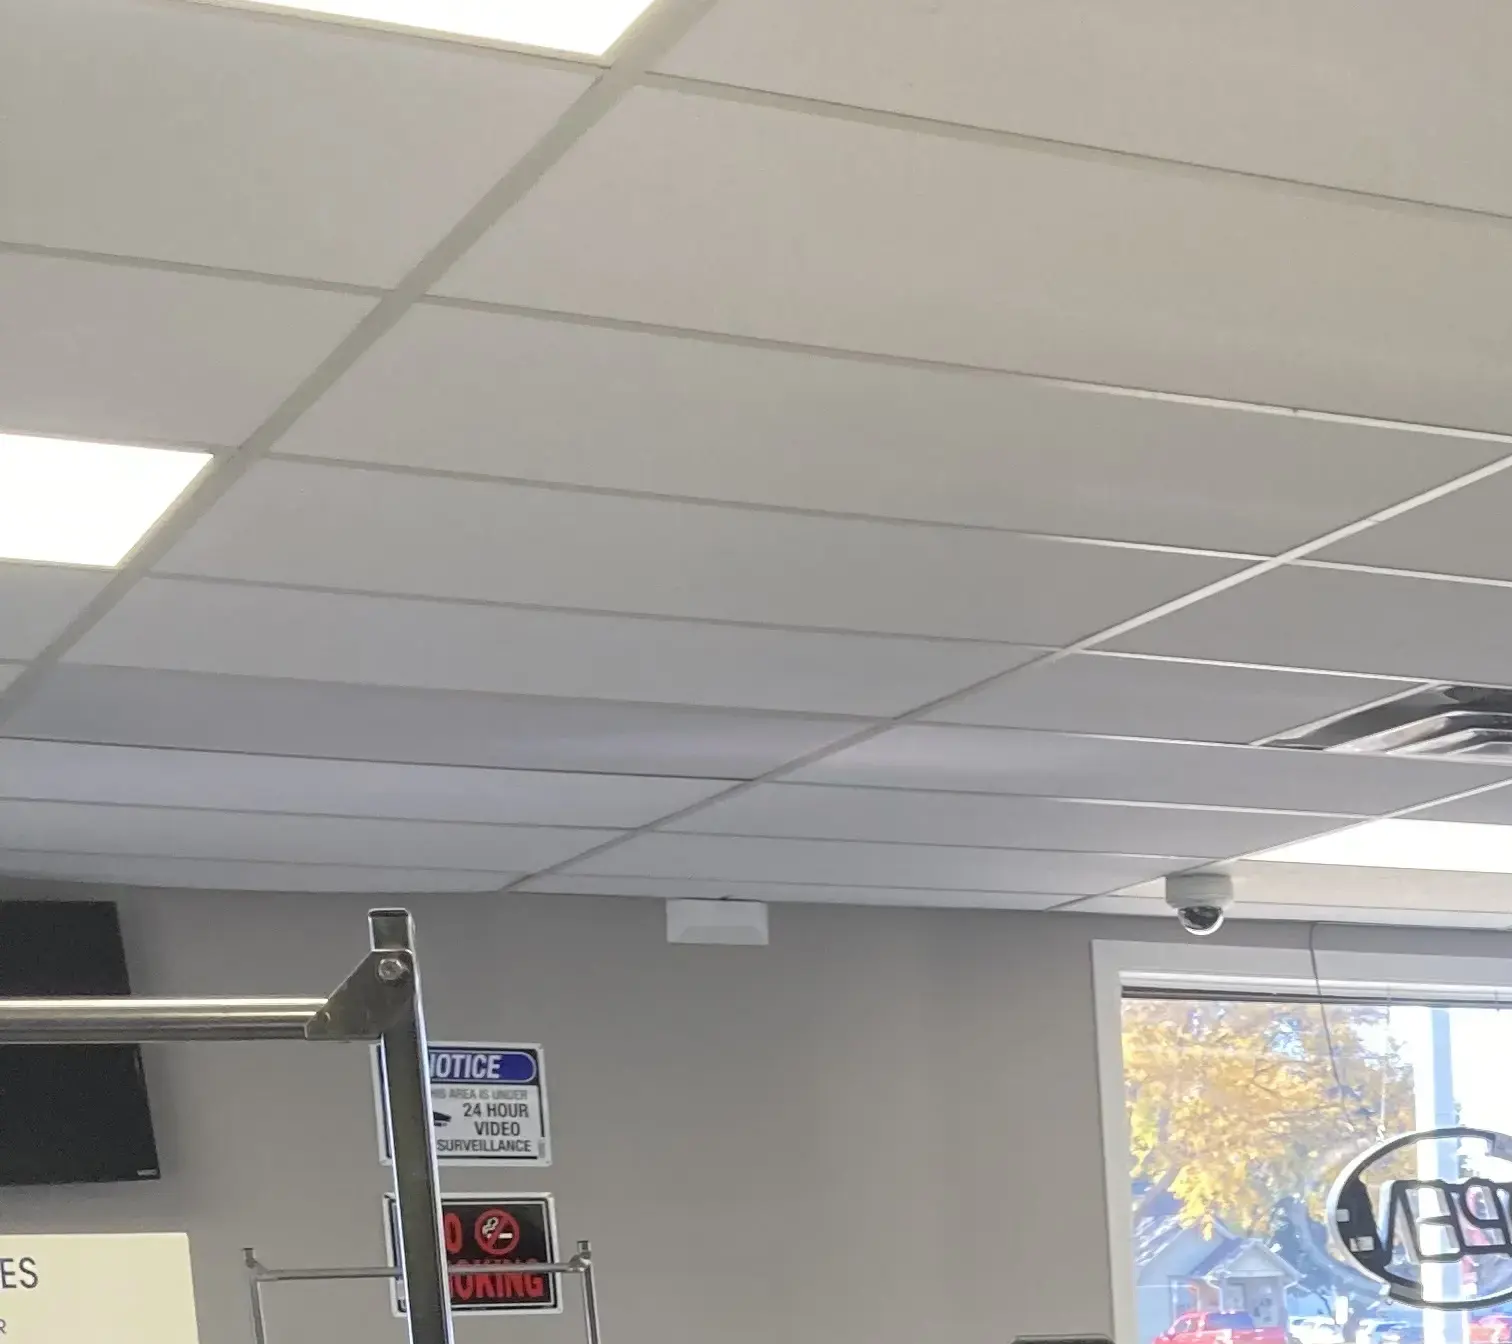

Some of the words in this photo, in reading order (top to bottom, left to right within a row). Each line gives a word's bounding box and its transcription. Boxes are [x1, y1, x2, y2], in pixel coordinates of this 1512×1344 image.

[449, 1088, 477, 1100] AREA
[479, 1088, 490, 1100] IS
[492, 1089, 528, 1101] UNDER
[462, 1102, 482, 1118] 24
[487, 1103, 530, 1118] HOUR
[474, 1121, 521, 1136] VIDEO
[437, 1139, 533, 1153] SURVEILLANCE
[441, 1212, 462, 1252] O
[449, 1258, 544, 1301] OKING
